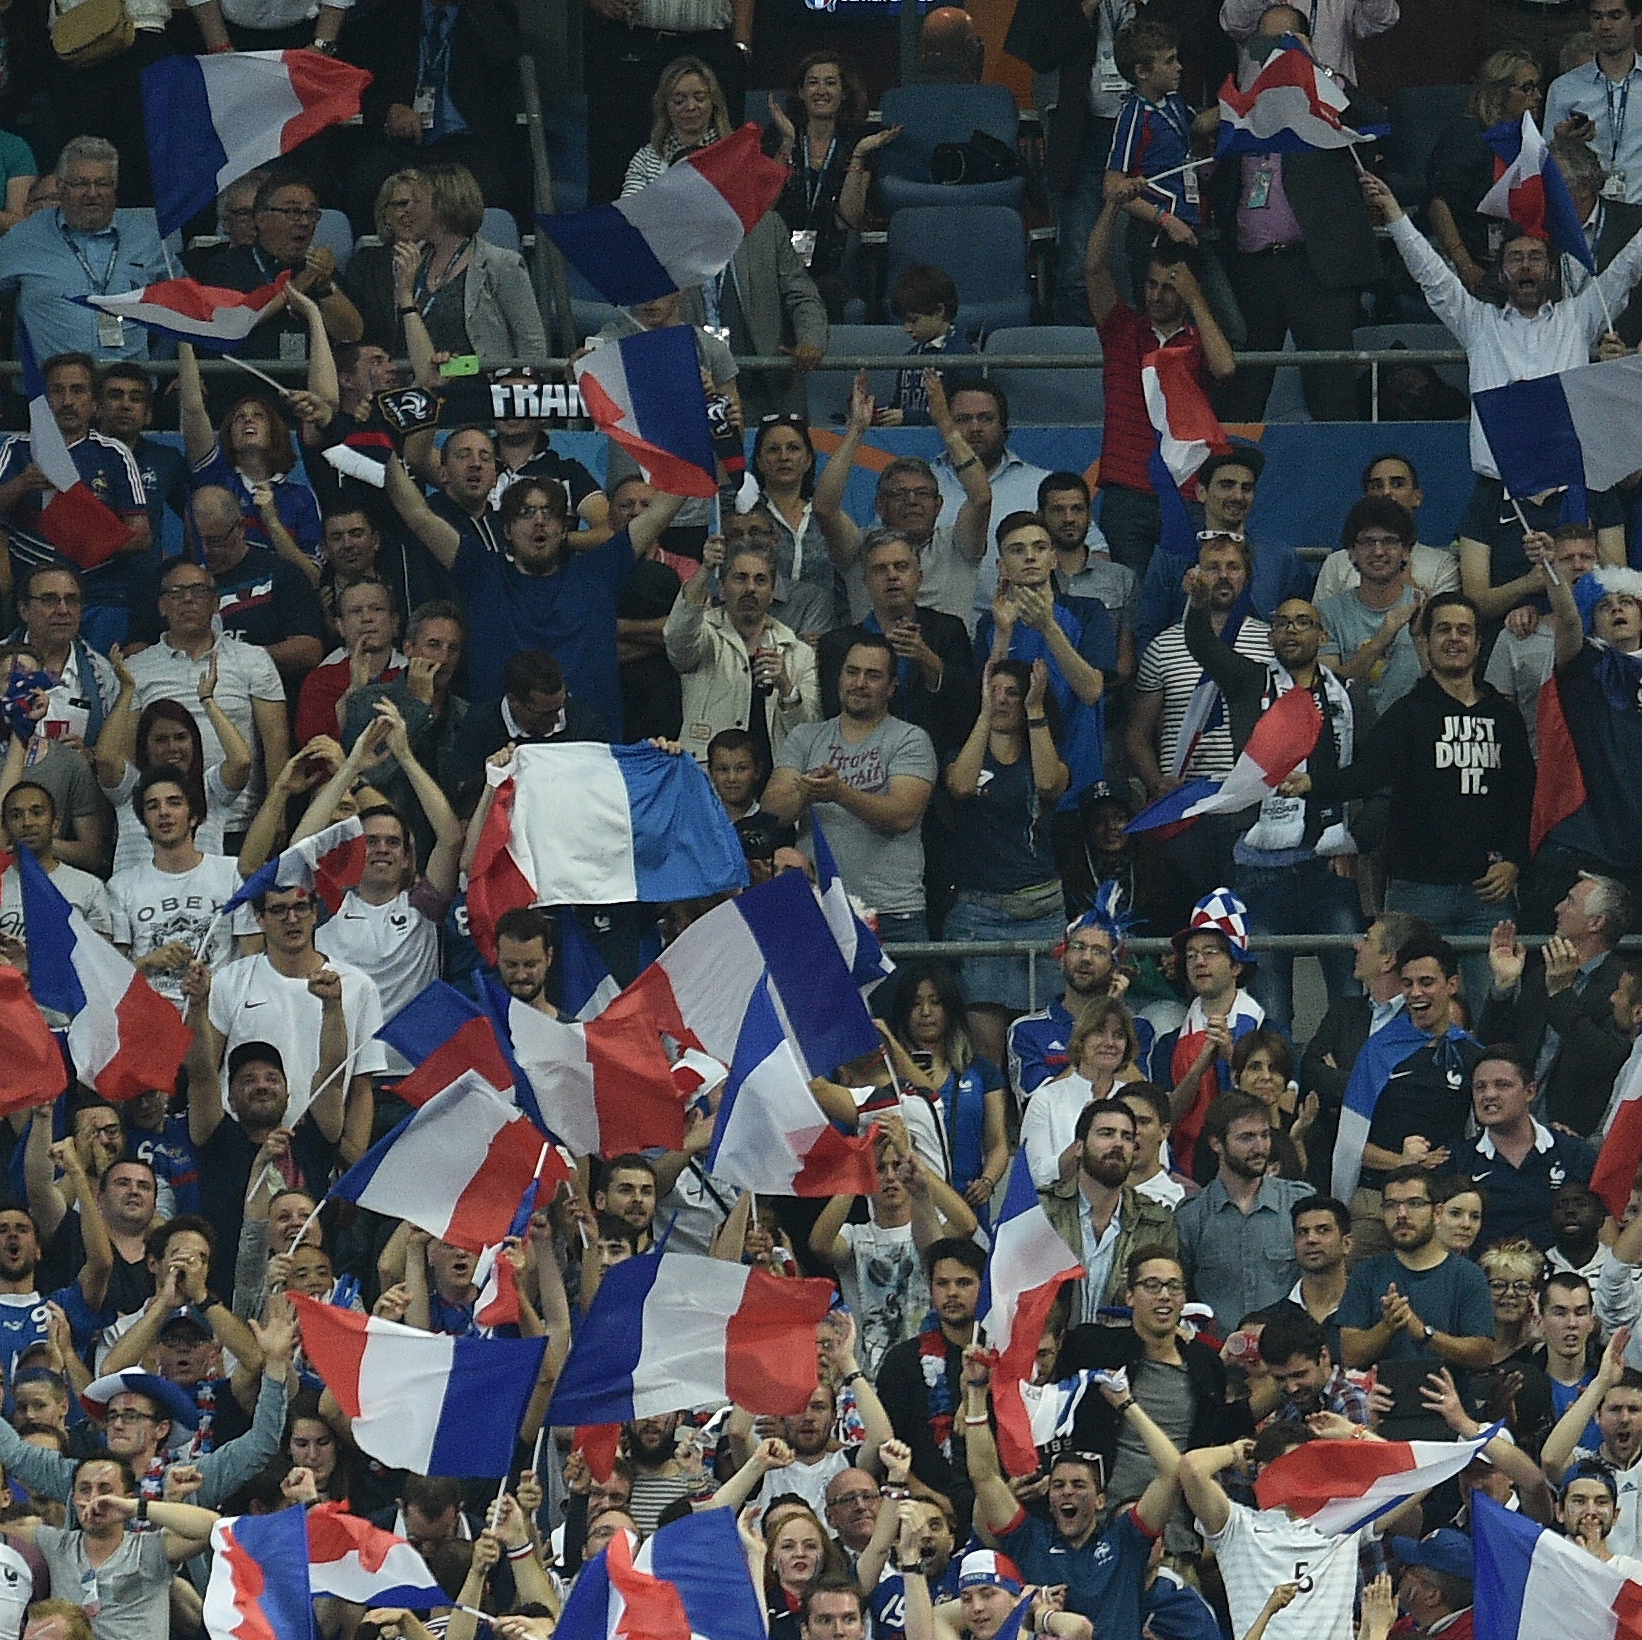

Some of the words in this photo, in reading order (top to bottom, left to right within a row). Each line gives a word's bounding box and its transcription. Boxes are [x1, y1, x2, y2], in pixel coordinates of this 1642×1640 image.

[1440, 715, 1497, 743] JUST
[1434, 741, 1502, 769] DUNK
[1460, 767, 1488, 795] IT.
[138, 896, 224, 922] OBEY
[1295, 1561, 1314, 1594] 5
